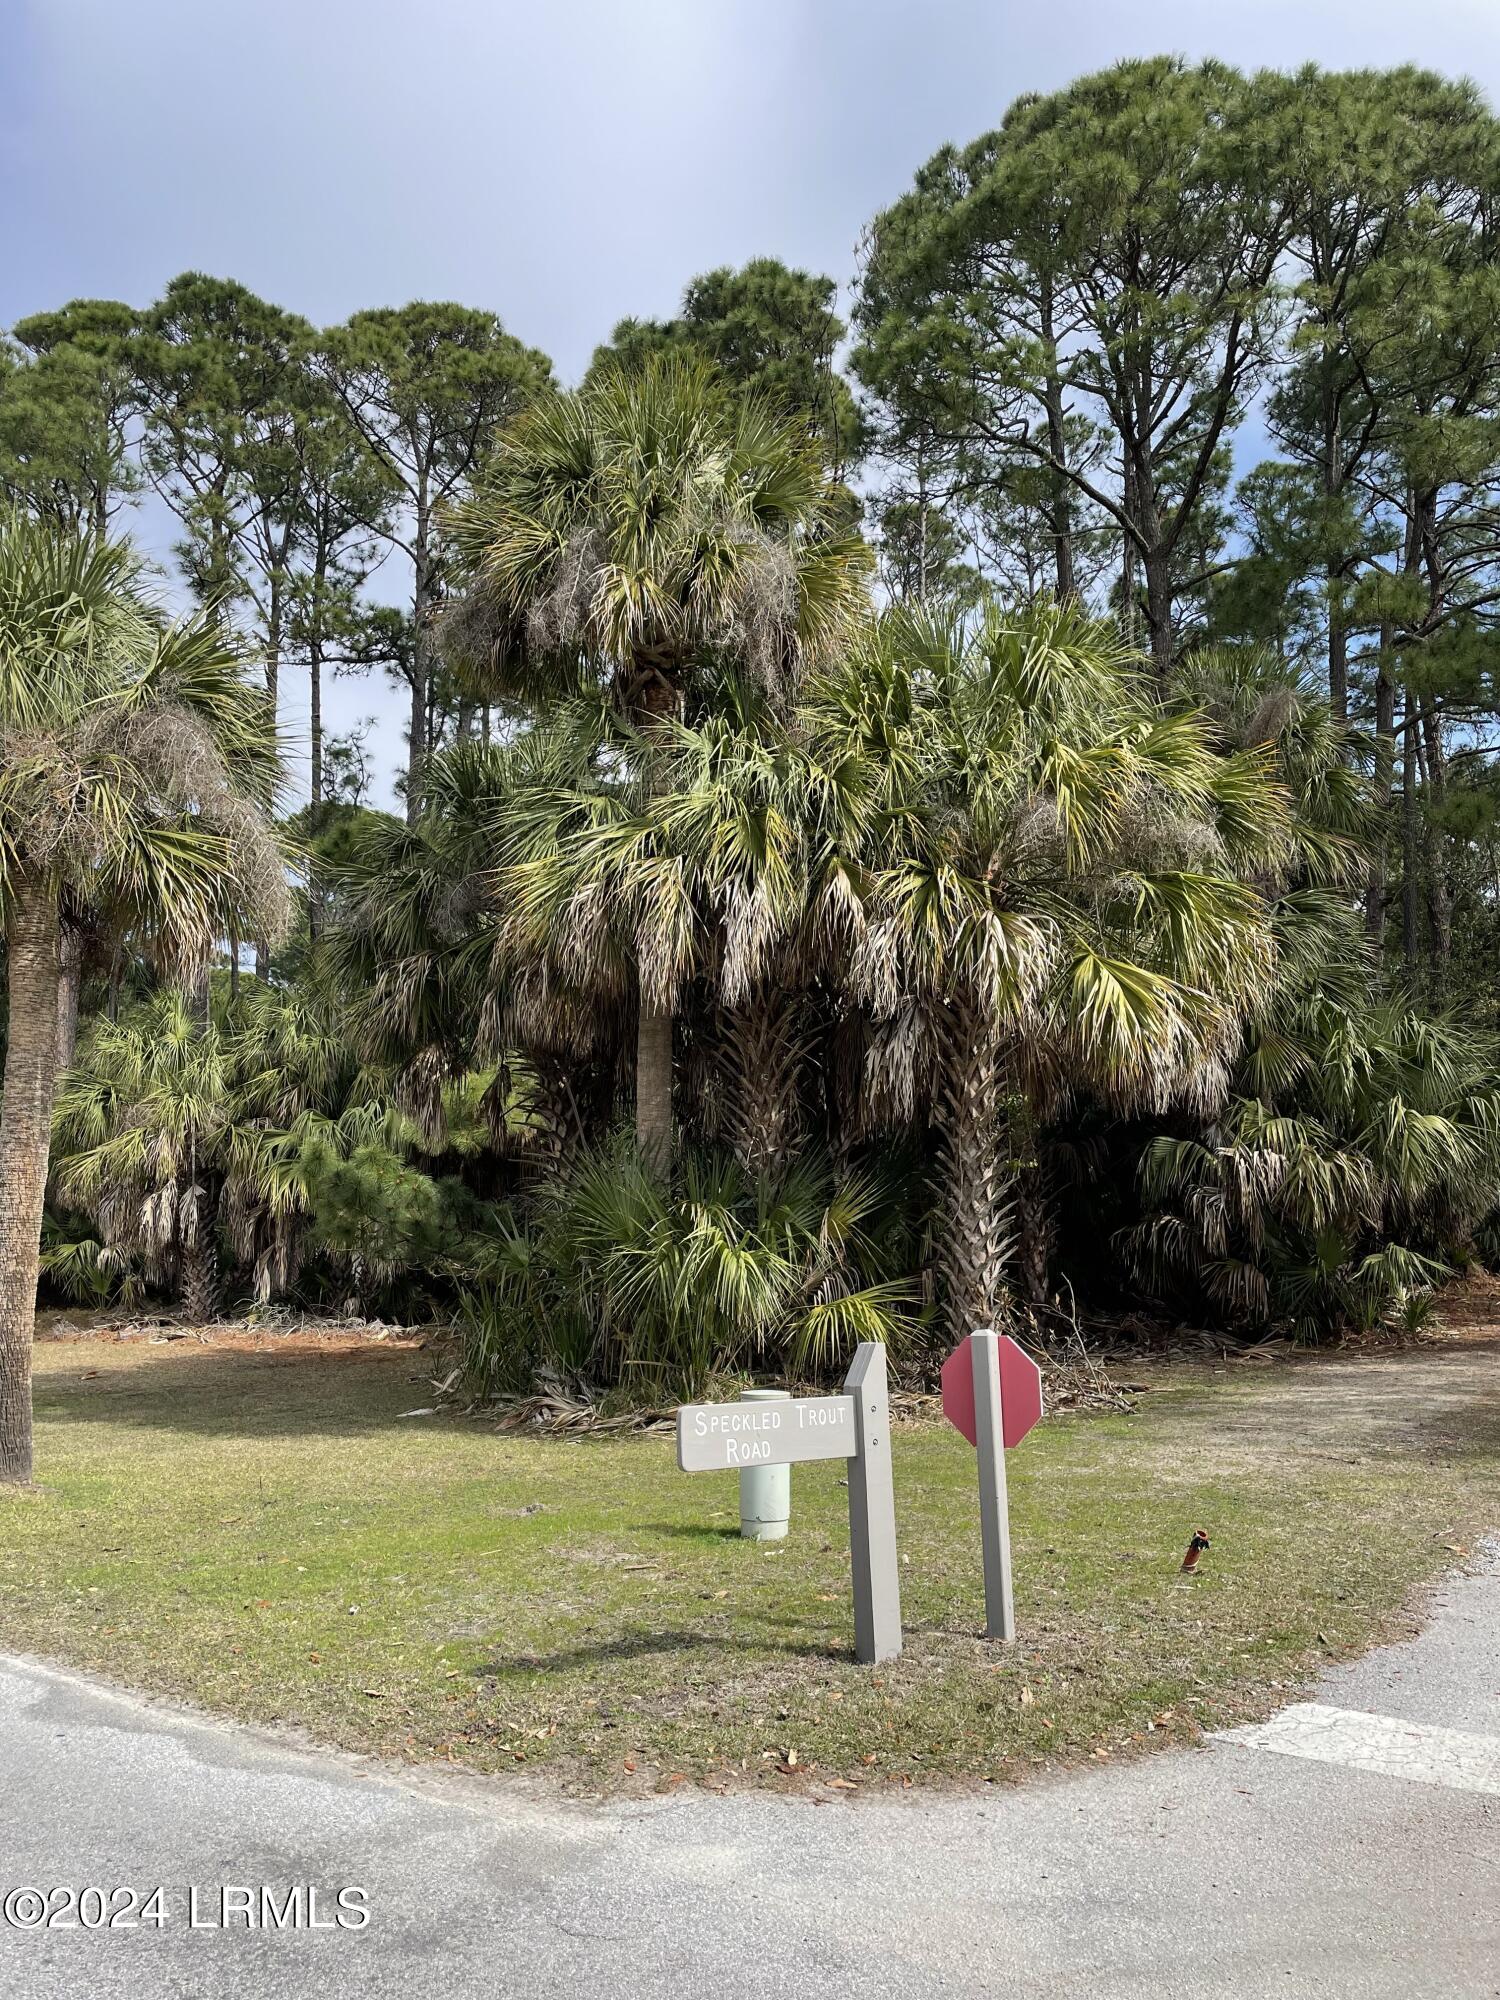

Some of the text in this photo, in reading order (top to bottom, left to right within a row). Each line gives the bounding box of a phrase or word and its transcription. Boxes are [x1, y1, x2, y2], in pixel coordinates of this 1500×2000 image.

[695, 1405, 846, 1436] SPECKLED TROUT
[726, 1438, 771, 1464] ROAD
